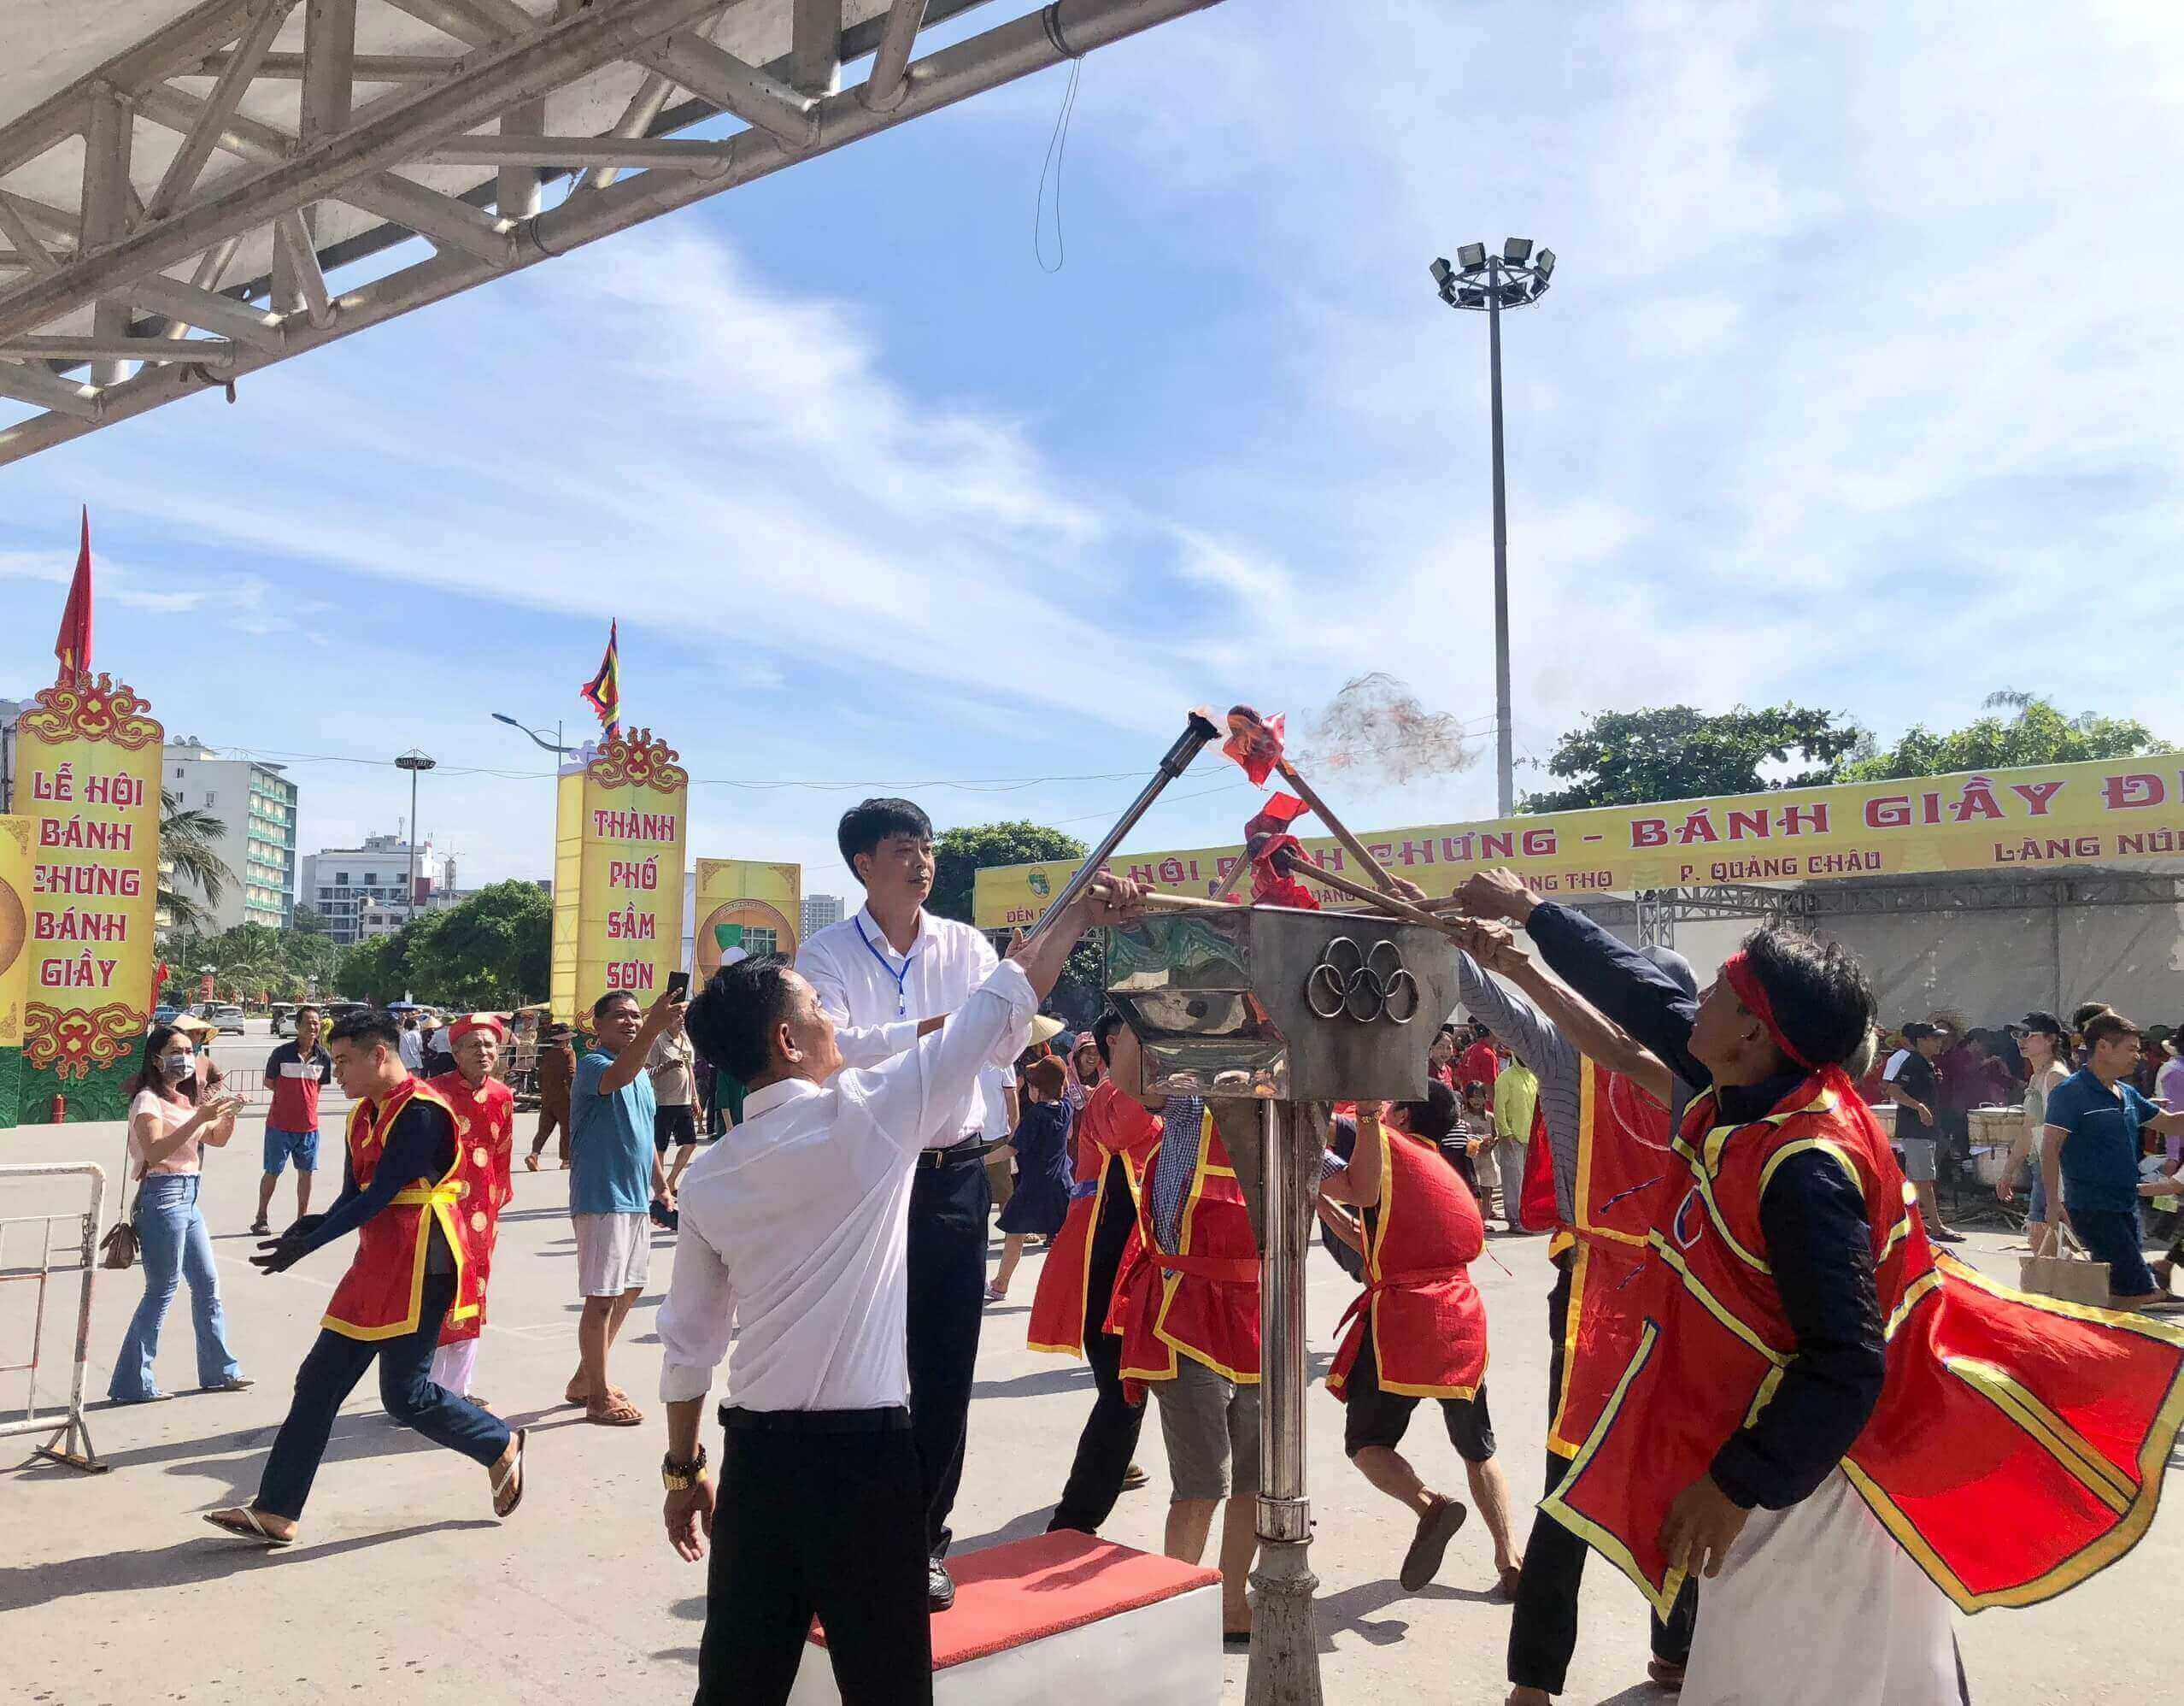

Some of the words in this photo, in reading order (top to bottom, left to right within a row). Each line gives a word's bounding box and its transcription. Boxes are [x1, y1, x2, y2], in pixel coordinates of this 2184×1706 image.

[33, 762, 73, 803] LỄ
[84, 773, 145, 813] HỘI
[39, 815, 132, 851] BÁNH
[594, 807, 676, 842] THÀNH
[1127, 856, 1200, 887] HỘI
[1368, 828, 1558, 867] CHƯNG
[1629, 803, 1830, 849] BÁNH
[1864, 774, 2066, 828] GIẦY
[2101, 766, 2184, 809] Đ
[1680, 864, 1701, 882] P.
[1710, 855, 1798, 883] QUẢNG
[1808, 849, 1882, 873] CHÂU
[1993, 837, 2101, 862] LÀNG
[609, 855, 660, 890] PHỐ
[1565, 870, 1613, 891] THỌ
[33, 906, 127, 942] BÁNH
[608, 902, 656, 939] SẦM
[40, 948, 118, 988] GIẦY
[606, 958, 654, 990] SƠN
